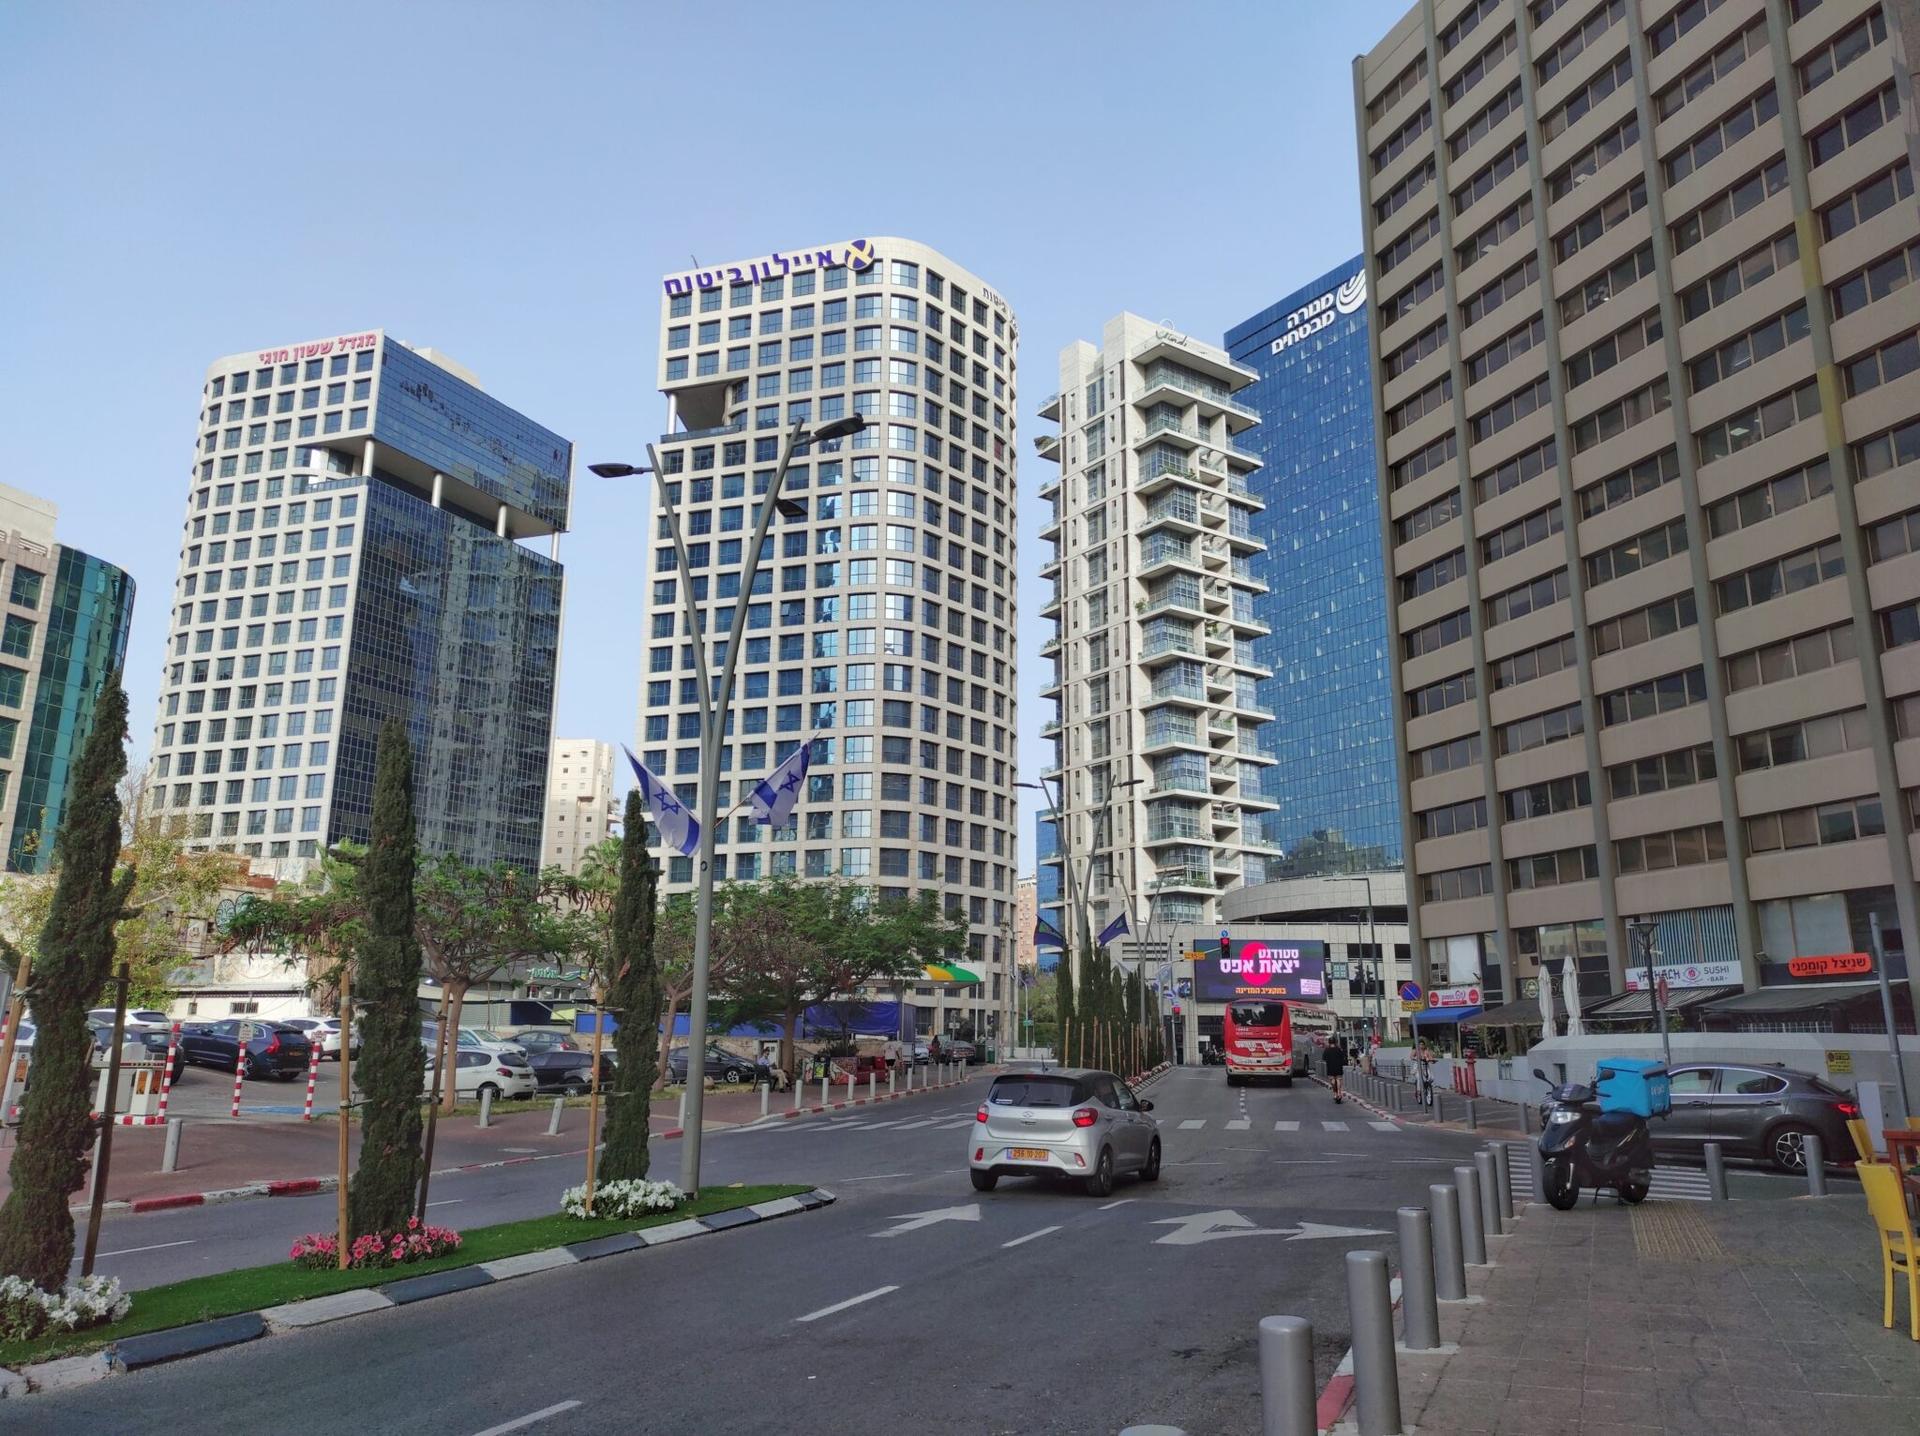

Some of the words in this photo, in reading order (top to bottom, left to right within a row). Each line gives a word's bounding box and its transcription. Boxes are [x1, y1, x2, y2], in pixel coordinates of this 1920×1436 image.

[750, 249, 836, 287] איילון
[664, 267, 745, 296] ביטוח
[1287, 293, 1334, 330] מנורה
[1271, 310, 1336, 355] מבטחים
[338, 333, 377, 352] מגדל
[258, 349, 290, 365] חוגי
[293, 341, 335, 361] ששון
[1258, 948, 1300, 959] סטודנט
[1220, 959, 1254, 974] אפס
[1259, 959, 1300, 974] יצאת
[1703, 965, 1730, 975] SUSHI
[1792, 960, 1828, 973] קומפני
[1831, 957, 1866, 969] שניצל
